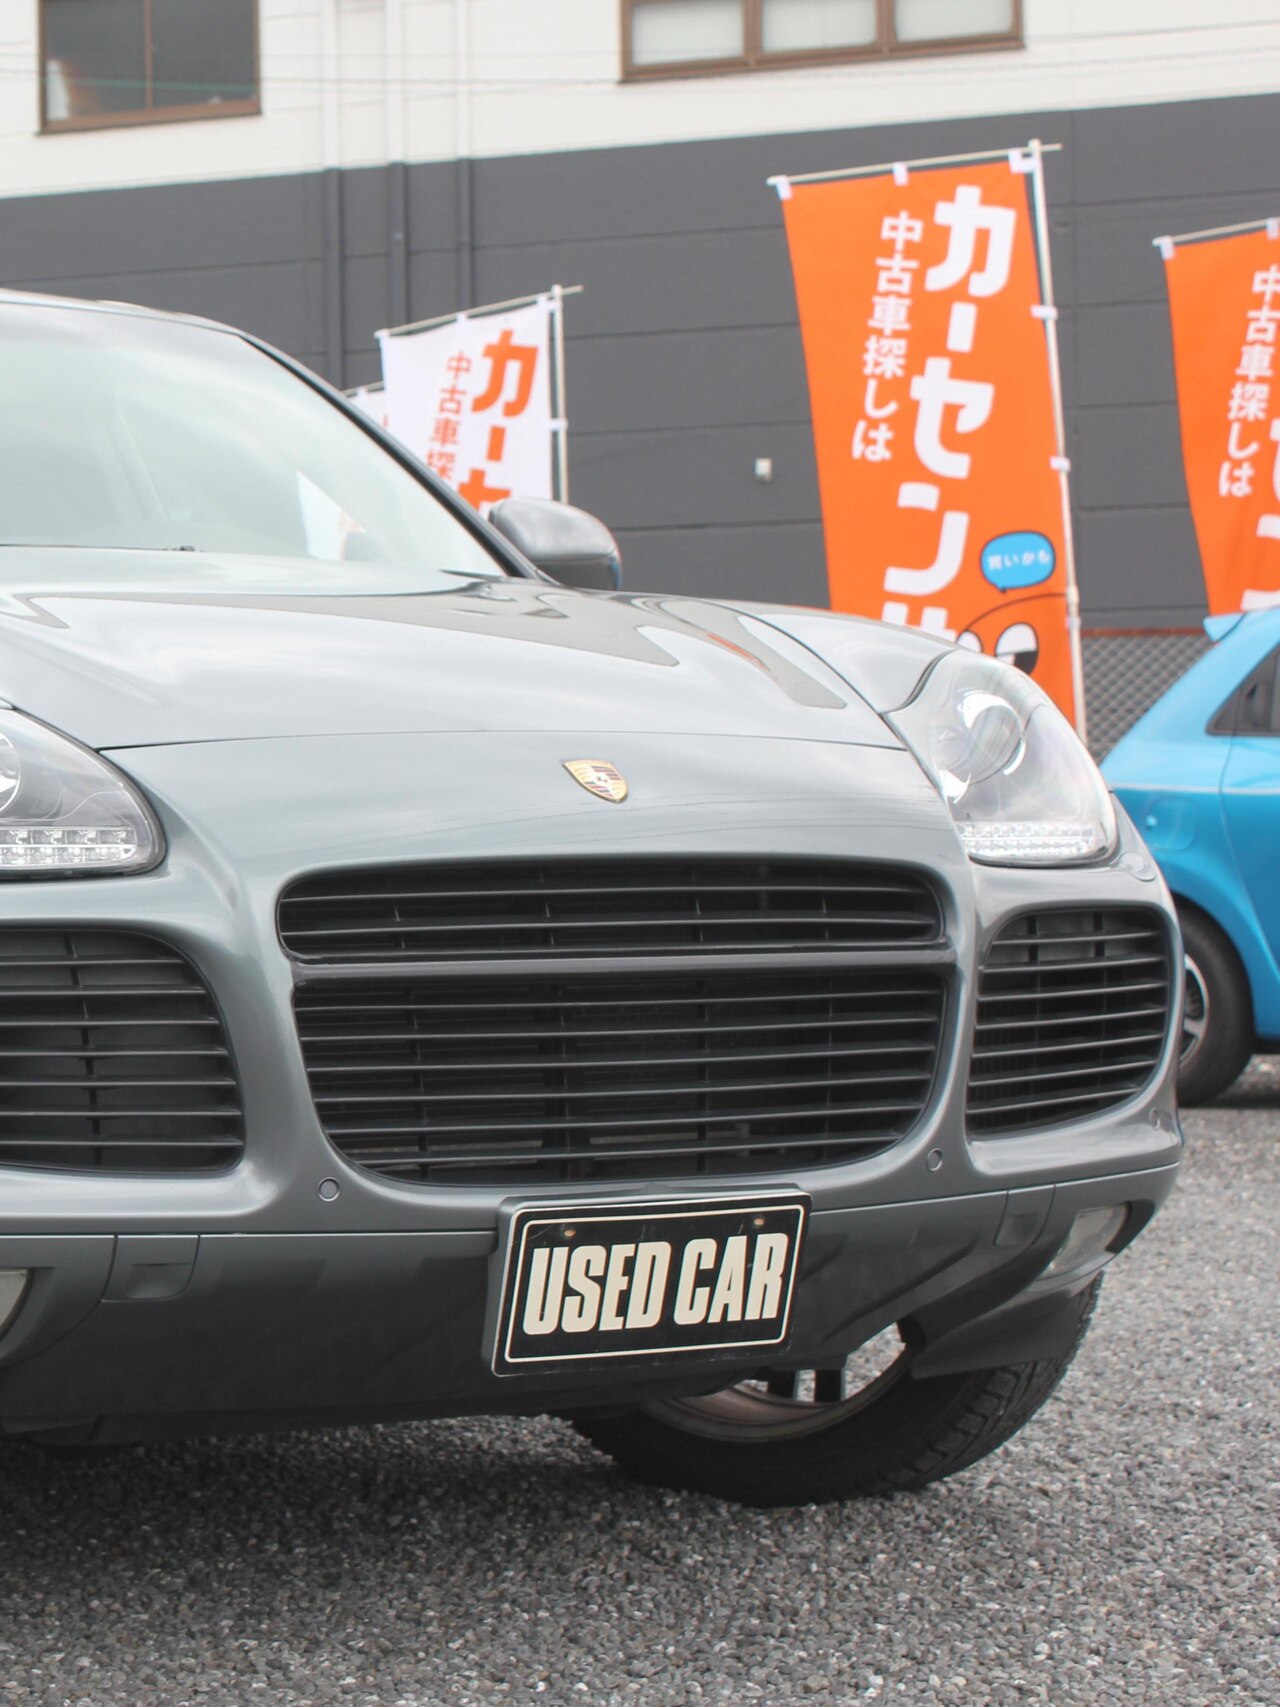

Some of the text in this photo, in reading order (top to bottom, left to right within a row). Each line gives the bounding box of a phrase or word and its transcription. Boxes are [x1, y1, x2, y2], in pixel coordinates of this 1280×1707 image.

[852, 210, 924, 462] 中古車探しは
[1219, 263, 1280, 498] 中古車探しは
[522, 1232, 789, 1336] USED CAR
